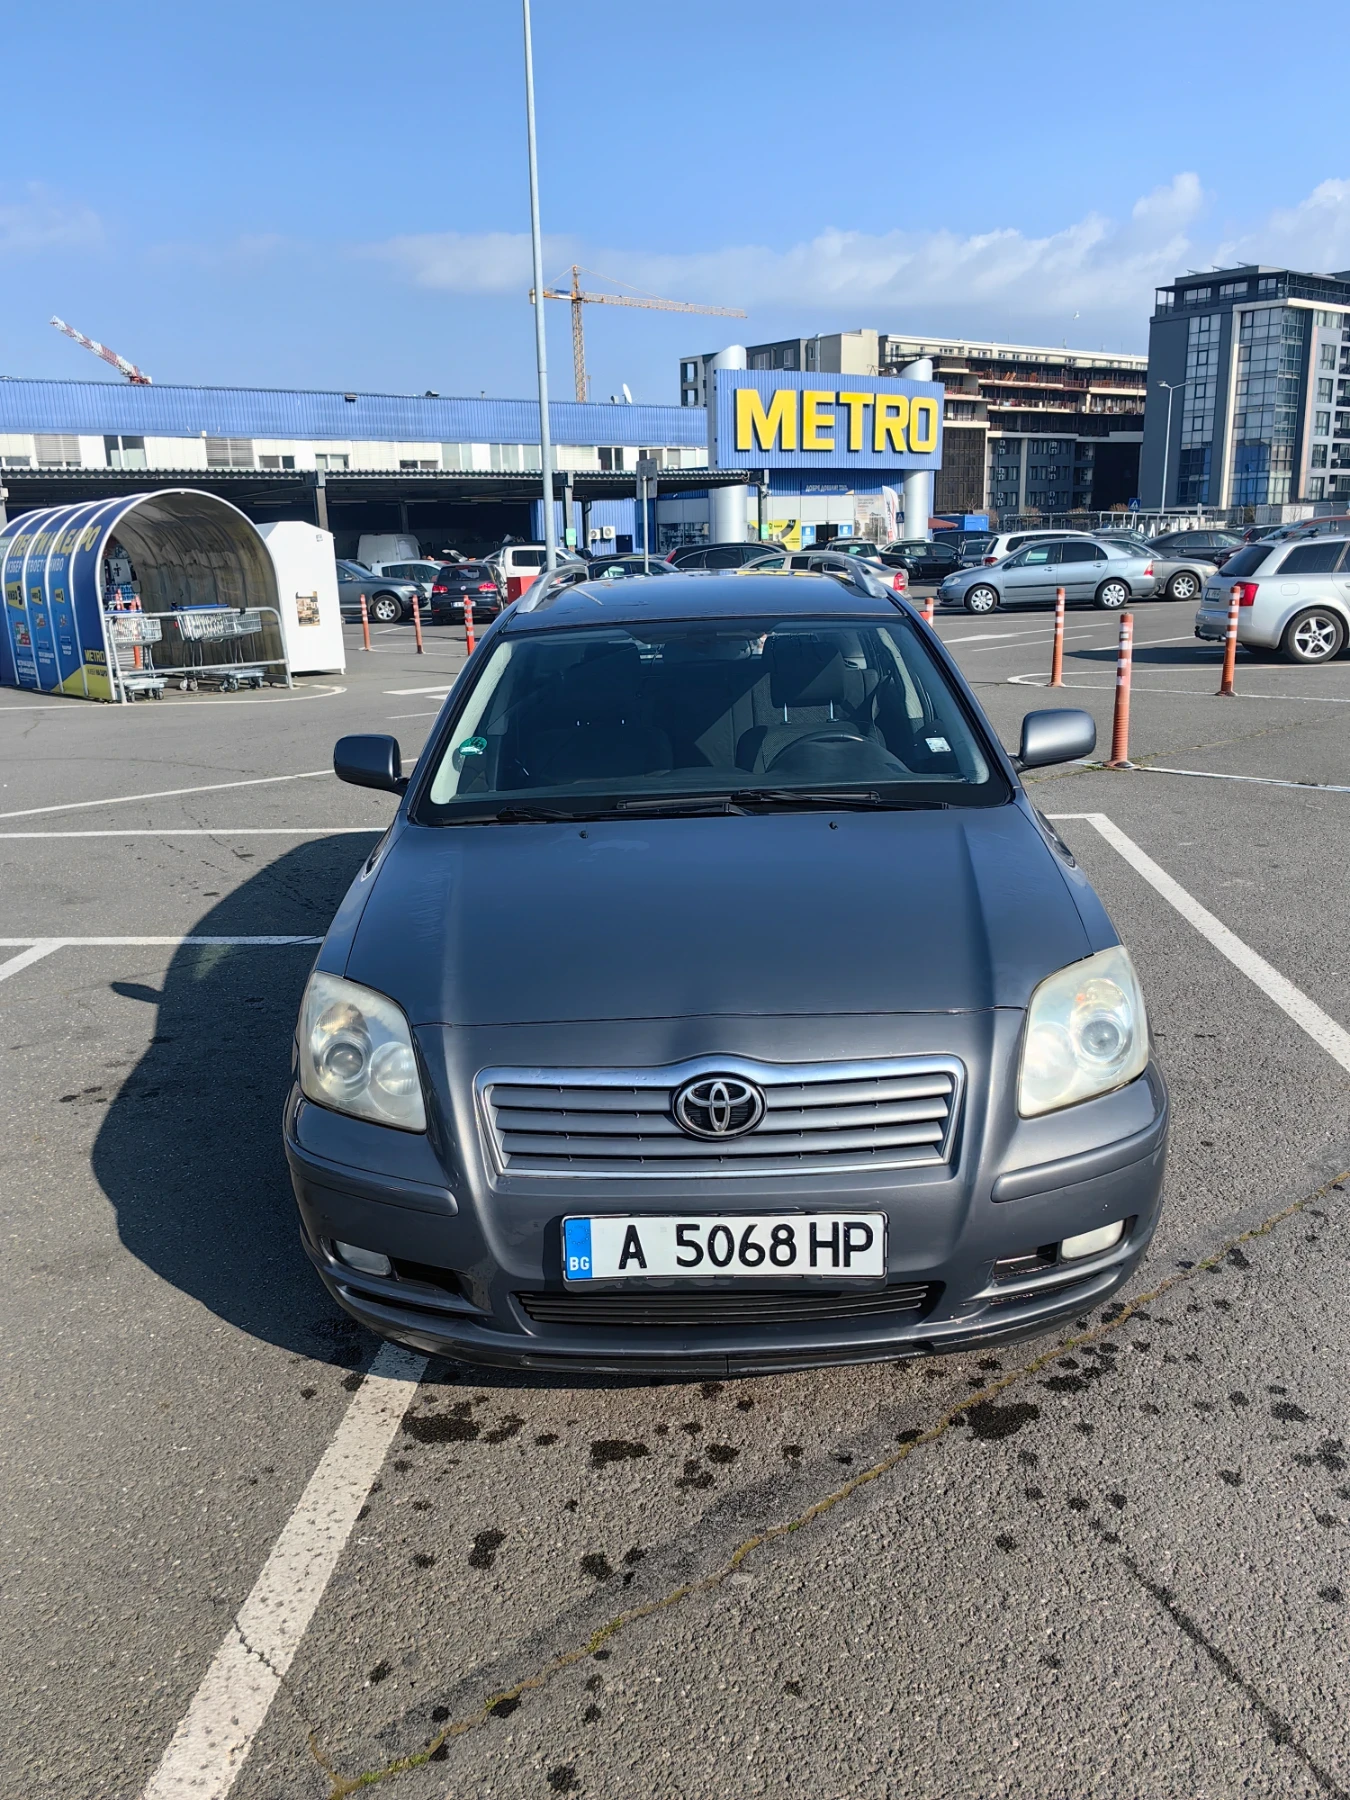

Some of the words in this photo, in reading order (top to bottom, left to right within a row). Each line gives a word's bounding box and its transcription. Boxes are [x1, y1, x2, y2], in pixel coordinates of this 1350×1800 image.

[735, 388, 939, 453] METRO
[6, 559, 24, 573] ИЗБЕР
[16, 585, 23, 605] 3
[84, 649, 106, 662] METRO
[618, 1224, 648, 1270] A
[675, 1223, 798, 1268] 5068
[808, 1221, 875, 1268] HP
[569, 1256, 590, 1271] BG
